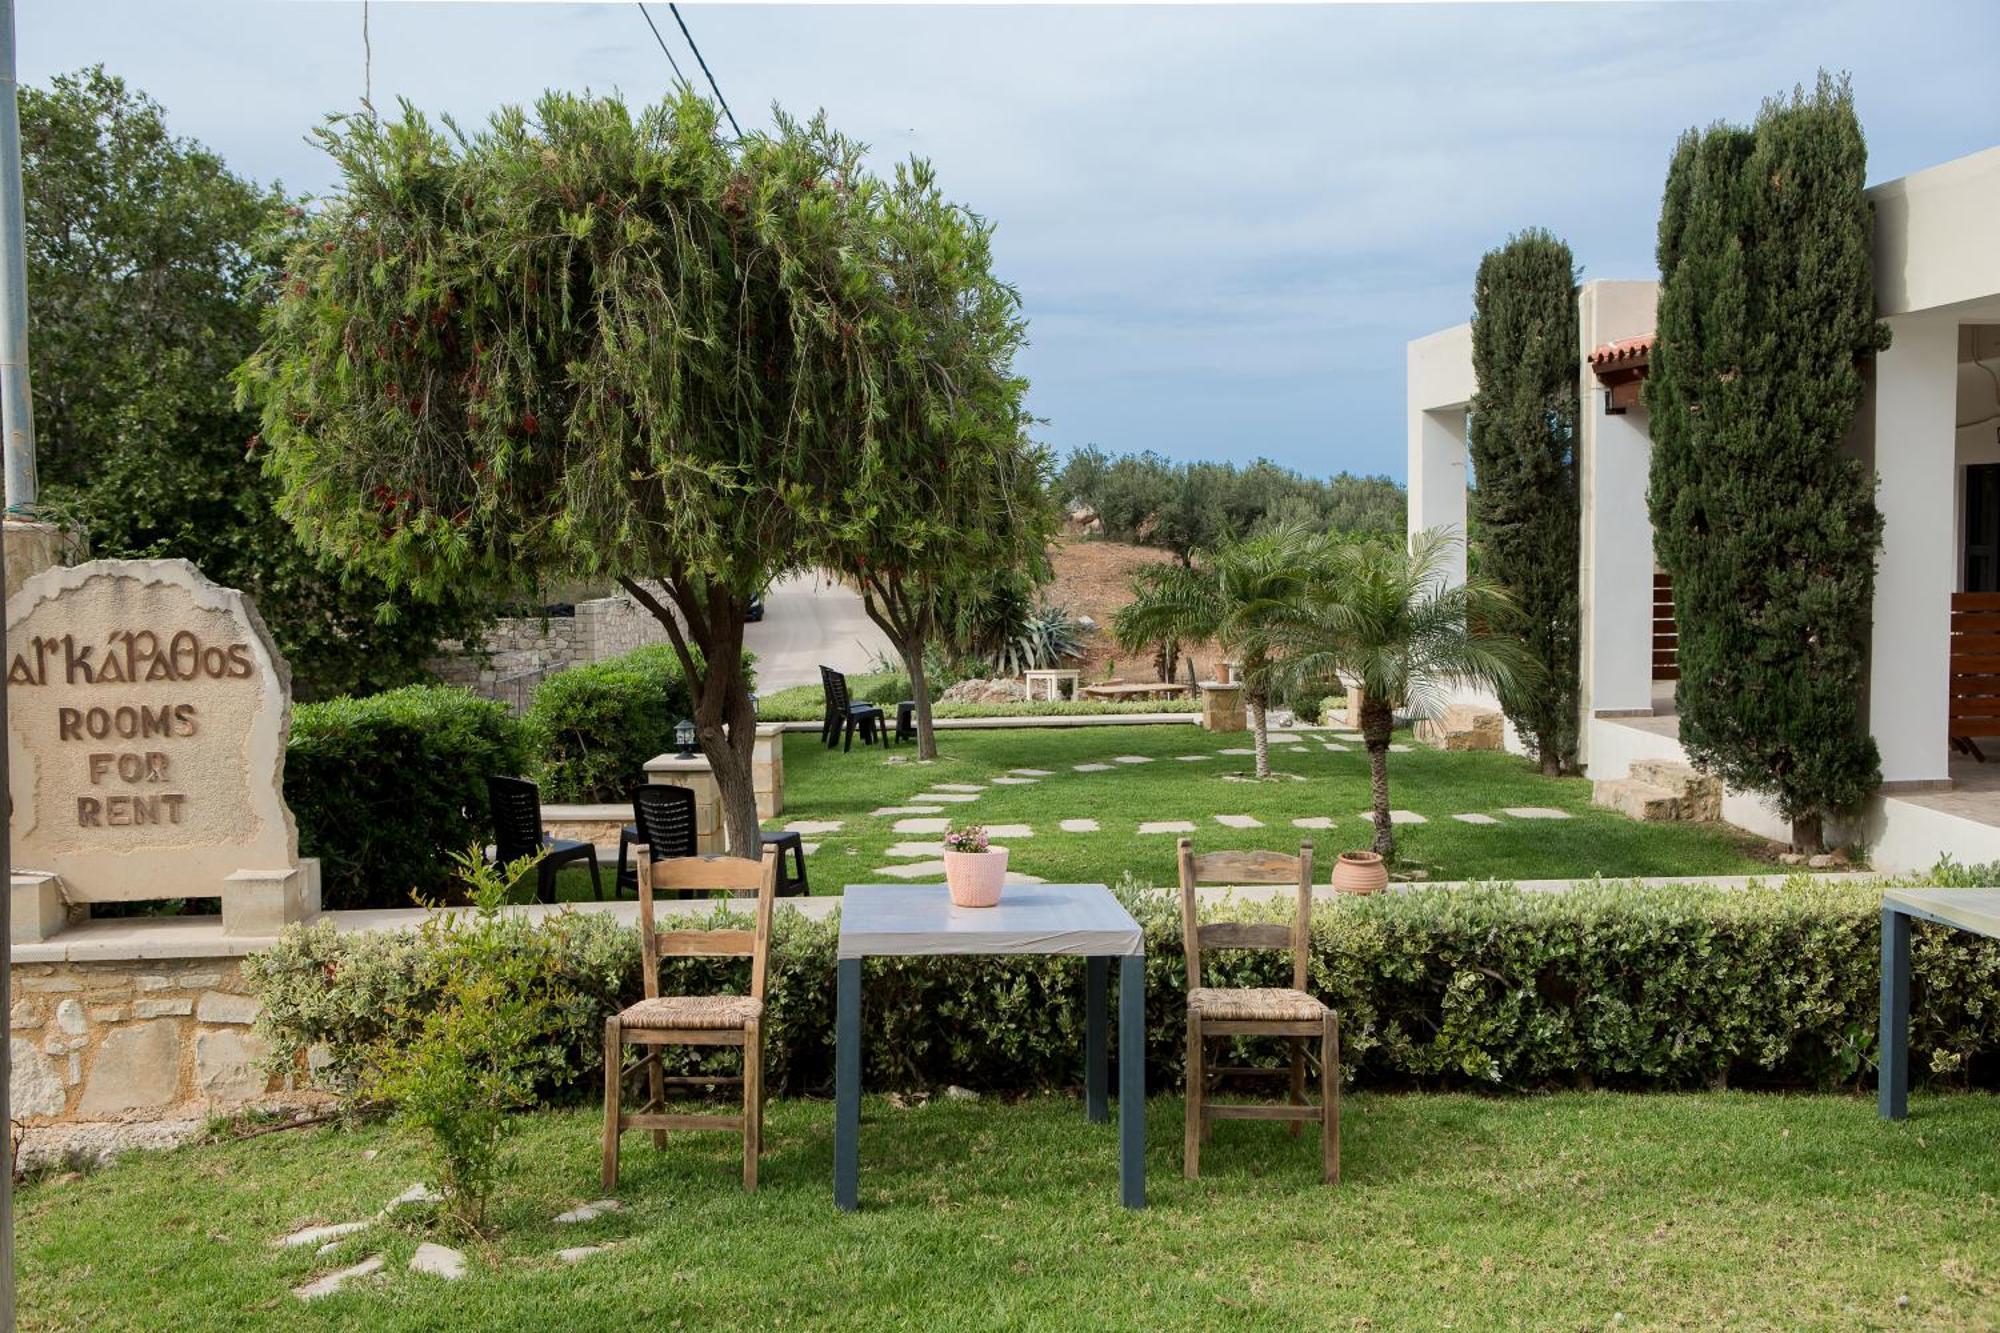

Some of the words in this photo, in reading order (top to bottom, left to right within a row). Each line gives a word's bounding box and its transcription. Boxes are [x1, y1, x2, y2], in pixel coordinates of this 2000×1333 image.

[59, 703, 199, 741] ROOMS
[89, 751, 170, 784] FOR
[77, 794, 185, 828] RENT
